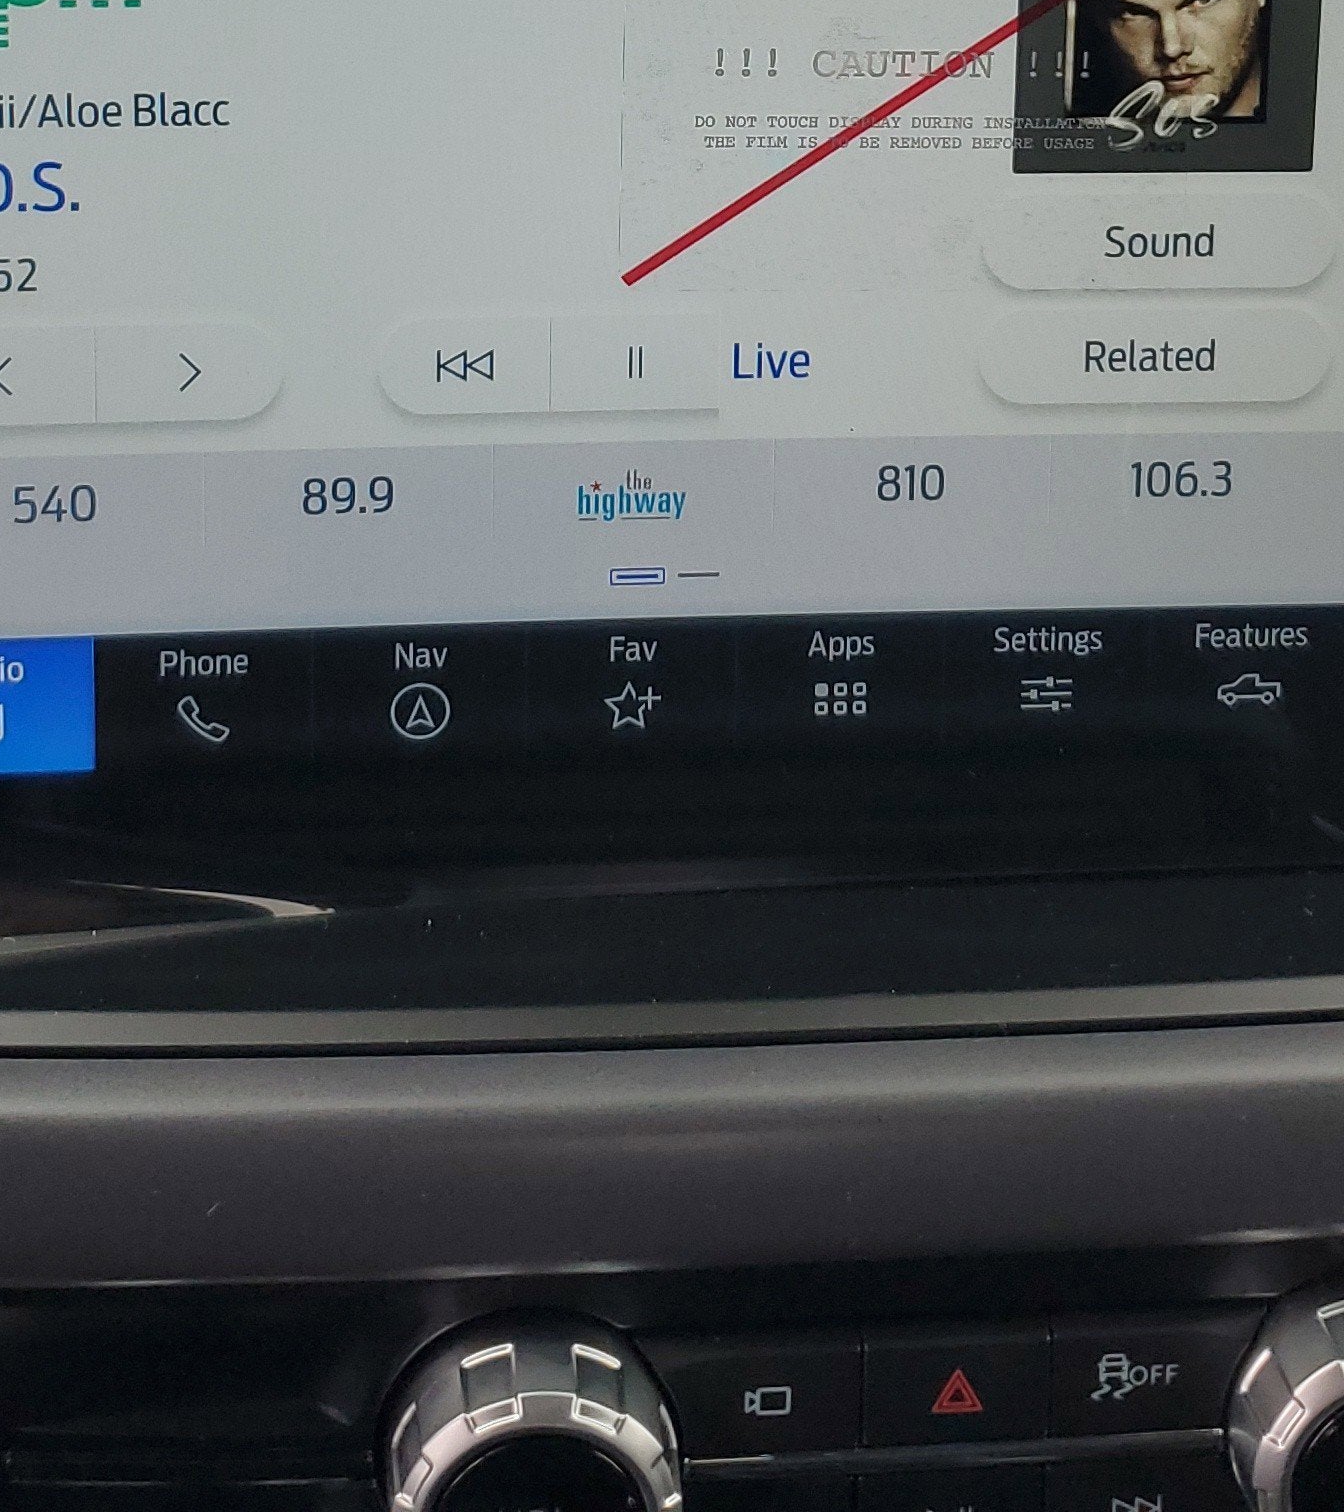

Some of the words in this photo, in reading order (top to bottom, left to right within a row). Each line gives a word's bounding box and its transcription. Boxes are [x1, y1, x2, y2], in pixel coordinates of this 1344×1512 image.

[812, 50, 996, 79] CAUTION
[132, 92, 231, 128] Blacc
[695, 115, 716, 128] DO
[725, 115, 757, 128] NOT
[767, 115, 819, 129] TOUCH
[829, 116, 902, 129] DISPLAY
[910, 116, 974, 129] DURING
[983, 116, 1108, 130] INSTALLATION
[704, 136, 736, 149] THE
[745, 136, 789, 149] FILM
[797, 136, 818, 149] IS
[859, 137, 881, 149] BE
[890, 137, 962, 149] REMOVED
[972, 137, 1033, 149] BEFORE
[1043, 137, 1095, 149] USAGE
[1104, 224, 1216, 258] Sound
[732, 342, 811, 380] Live
[1083, 338, 1217, 374] Related
[626, 469, 652, 491] the
[876, 464, 945, 502] 810
[1130, 460, 1234, 499] 106.3
[12, 483, 98, 525] 540
[301, 475, 395, 516] 89.9
[577, 485, 687, 522] highway
[609, 635, 658, 663] Fav
[808, 630, 876, 662] Apps
[993, 624, 1104, 655] Settings
[1194, 622, 1309, 650] Features
[159, 649, 249, 678] Phone
[394, 642, 448, 671] Nav
[1129, 1363, 1179, 1386] OFF
